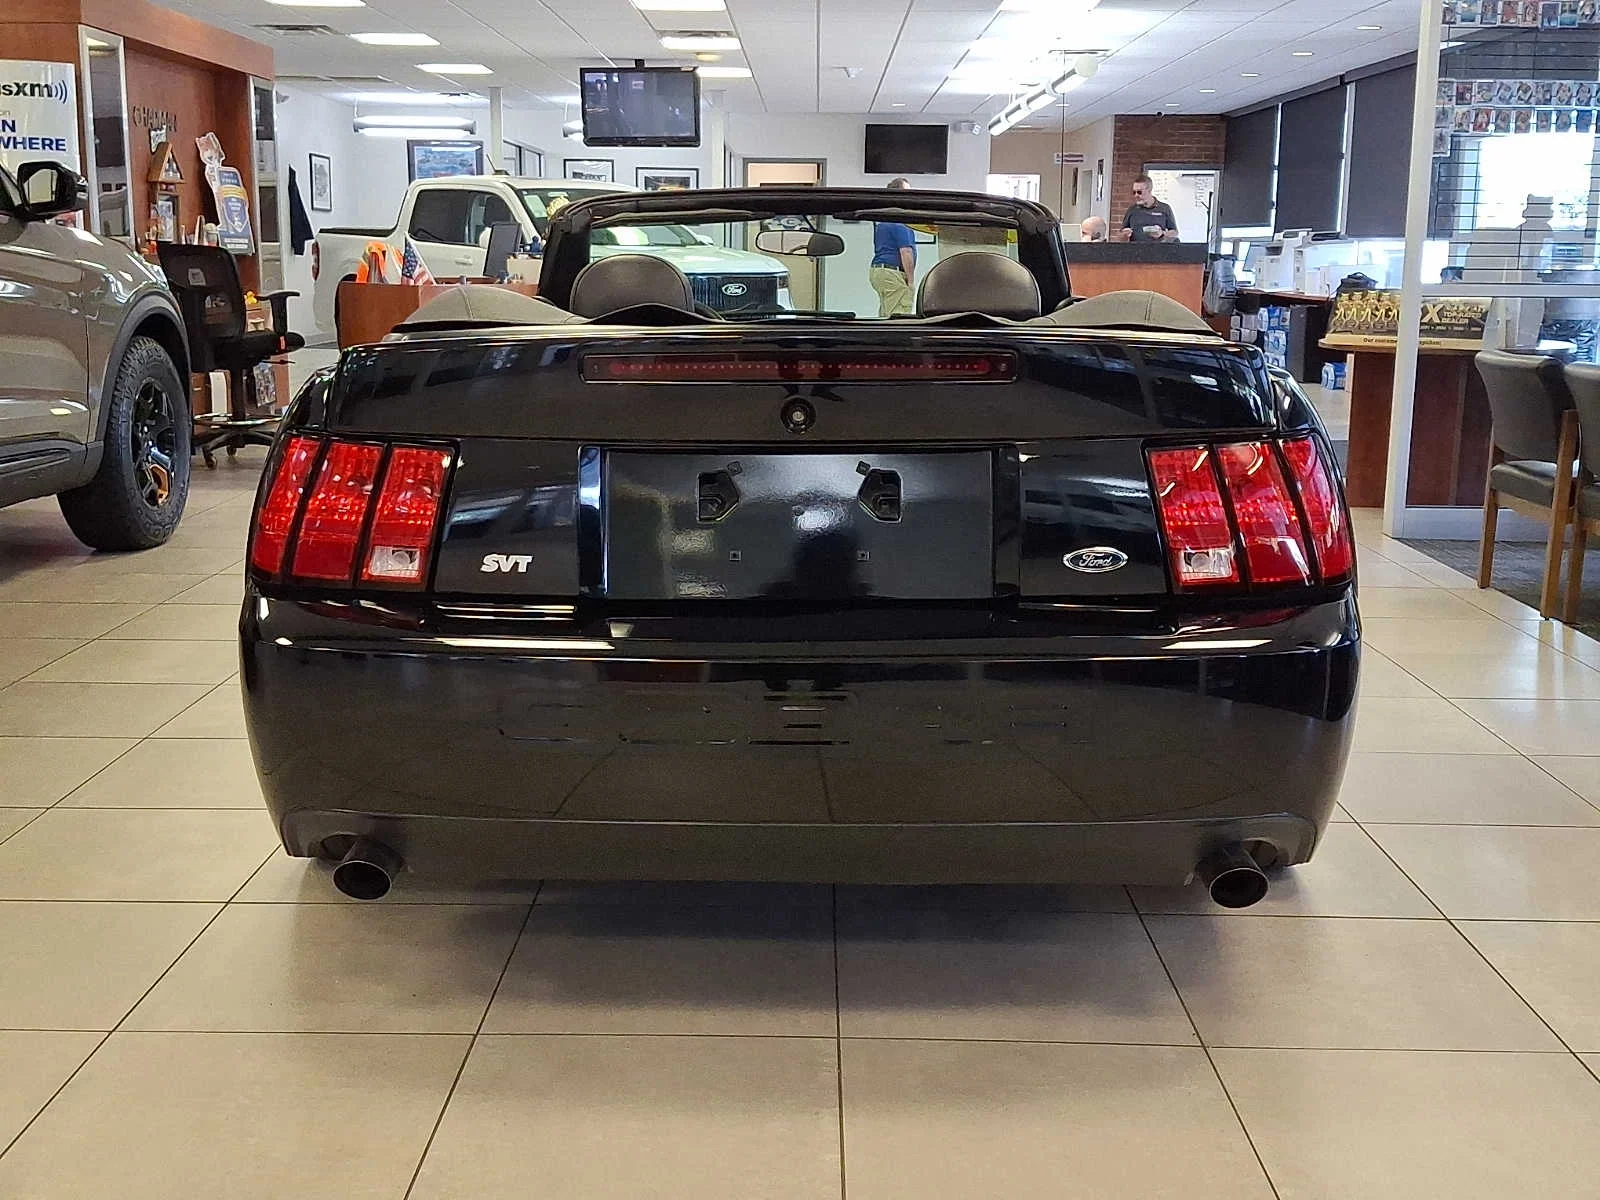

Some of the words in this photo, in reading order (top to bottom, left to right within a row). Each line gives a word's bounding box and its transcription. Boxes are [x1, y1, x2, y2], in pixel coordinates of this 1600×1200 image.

[0, 82, 53, 98] sxm
[1420, 303, 1445, 323] X
[480, 553, 533, 573] SVT
